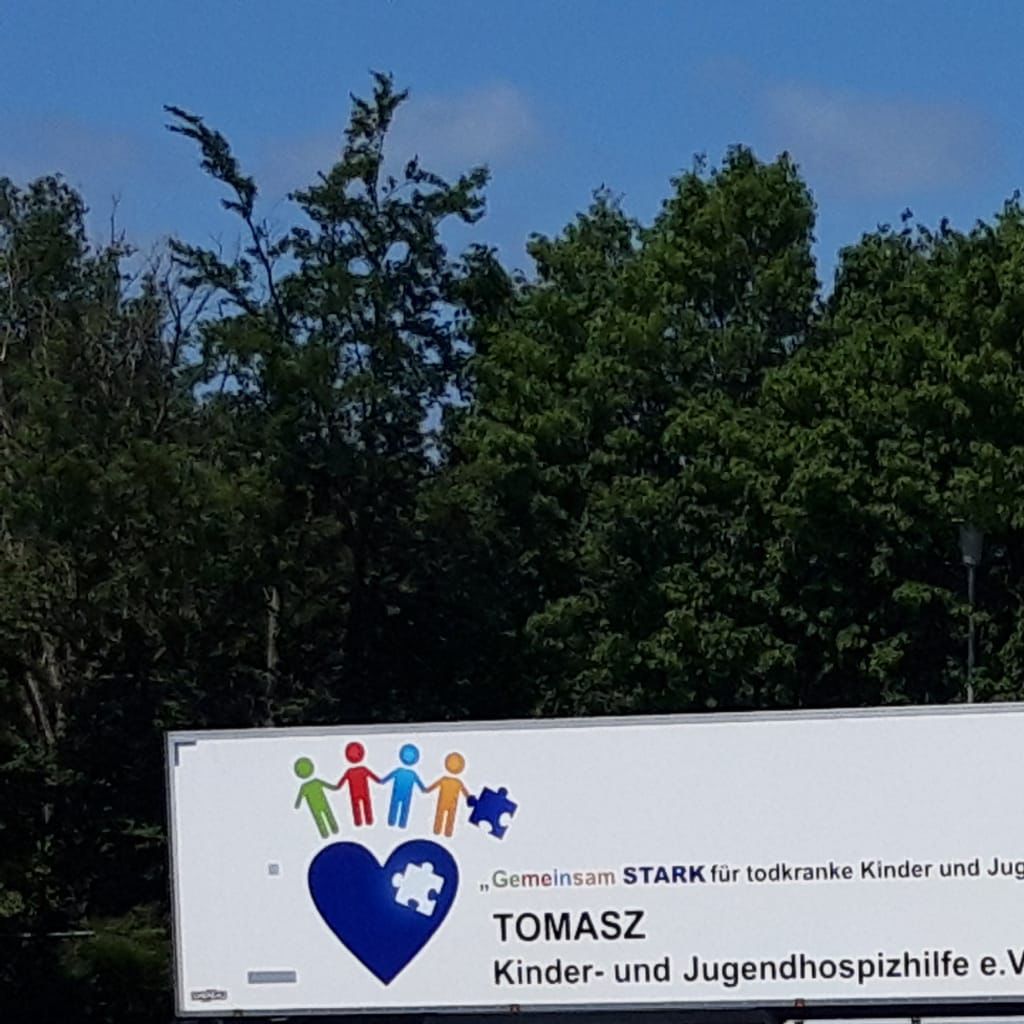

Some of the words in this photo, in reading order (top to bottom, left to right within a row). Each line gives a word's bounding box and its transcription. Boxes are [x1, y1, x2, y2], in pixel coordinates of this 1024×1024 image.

[622, 865, 706, 885] STARK
[711, 864, 740, 884] für
[746, 861, 853, 882] todkranke
[861, 859, 933, 880] Kinder
[940, 858, 980, 878] und
[493, 910, 647, 942] TOMASZ
[494, 958, 604, 986] Kinder-
[614, 956, 671, 983] und
[682, 949, 970, 988] Jugendhospizhilfe
